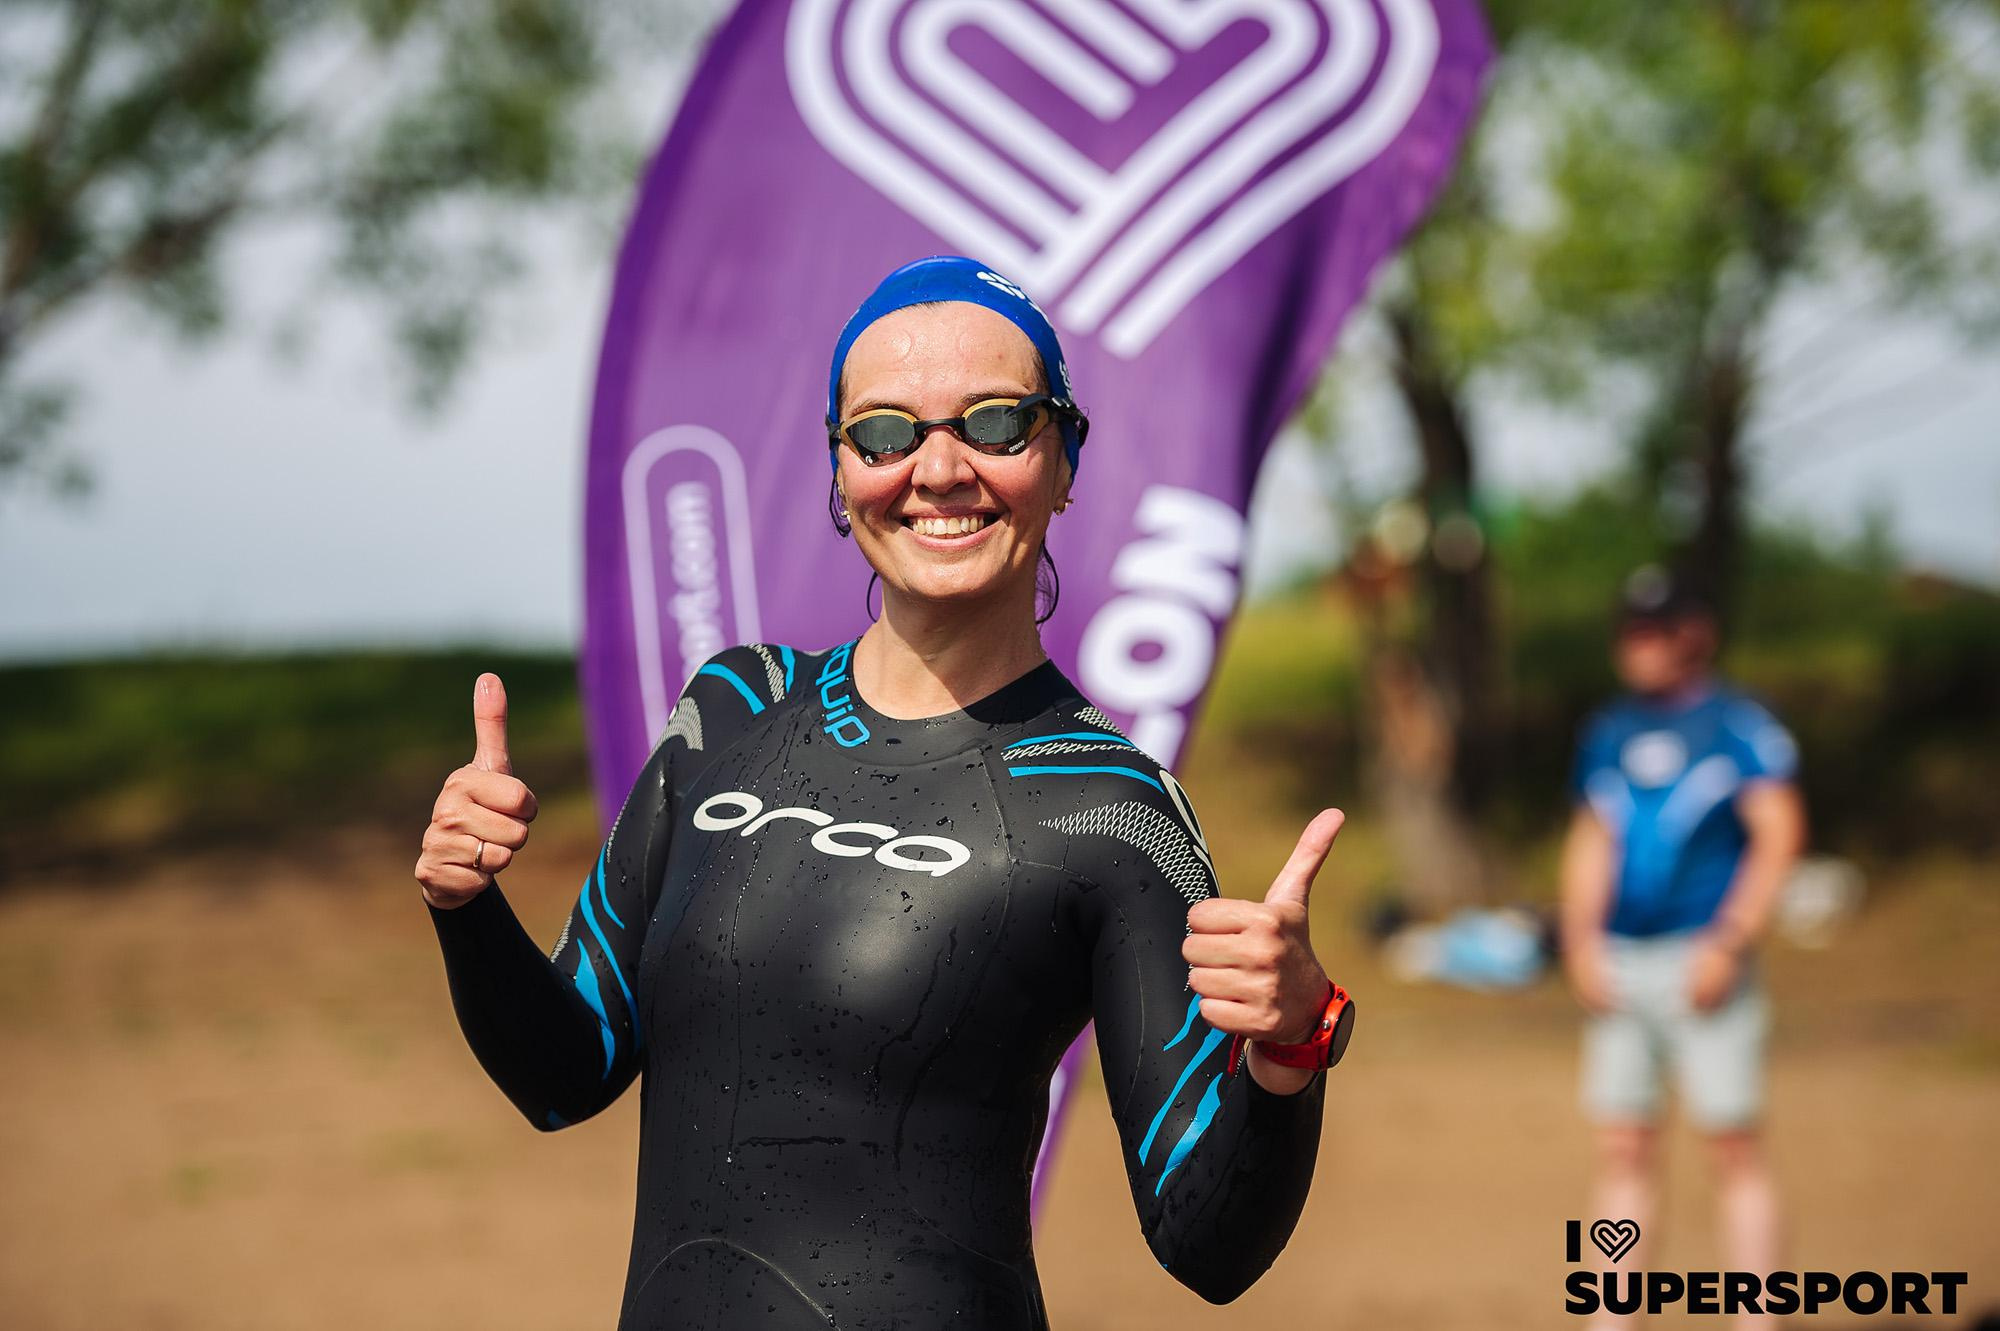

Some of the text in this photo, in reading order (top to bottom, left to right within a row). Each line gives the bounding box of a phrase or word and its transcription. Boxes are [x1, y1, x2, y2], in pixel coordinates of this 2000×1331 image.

[1009, 440, 1025, 453] arena
[1076, 484, 1246, 771] ON
[693, 792, 971, 877] orca
